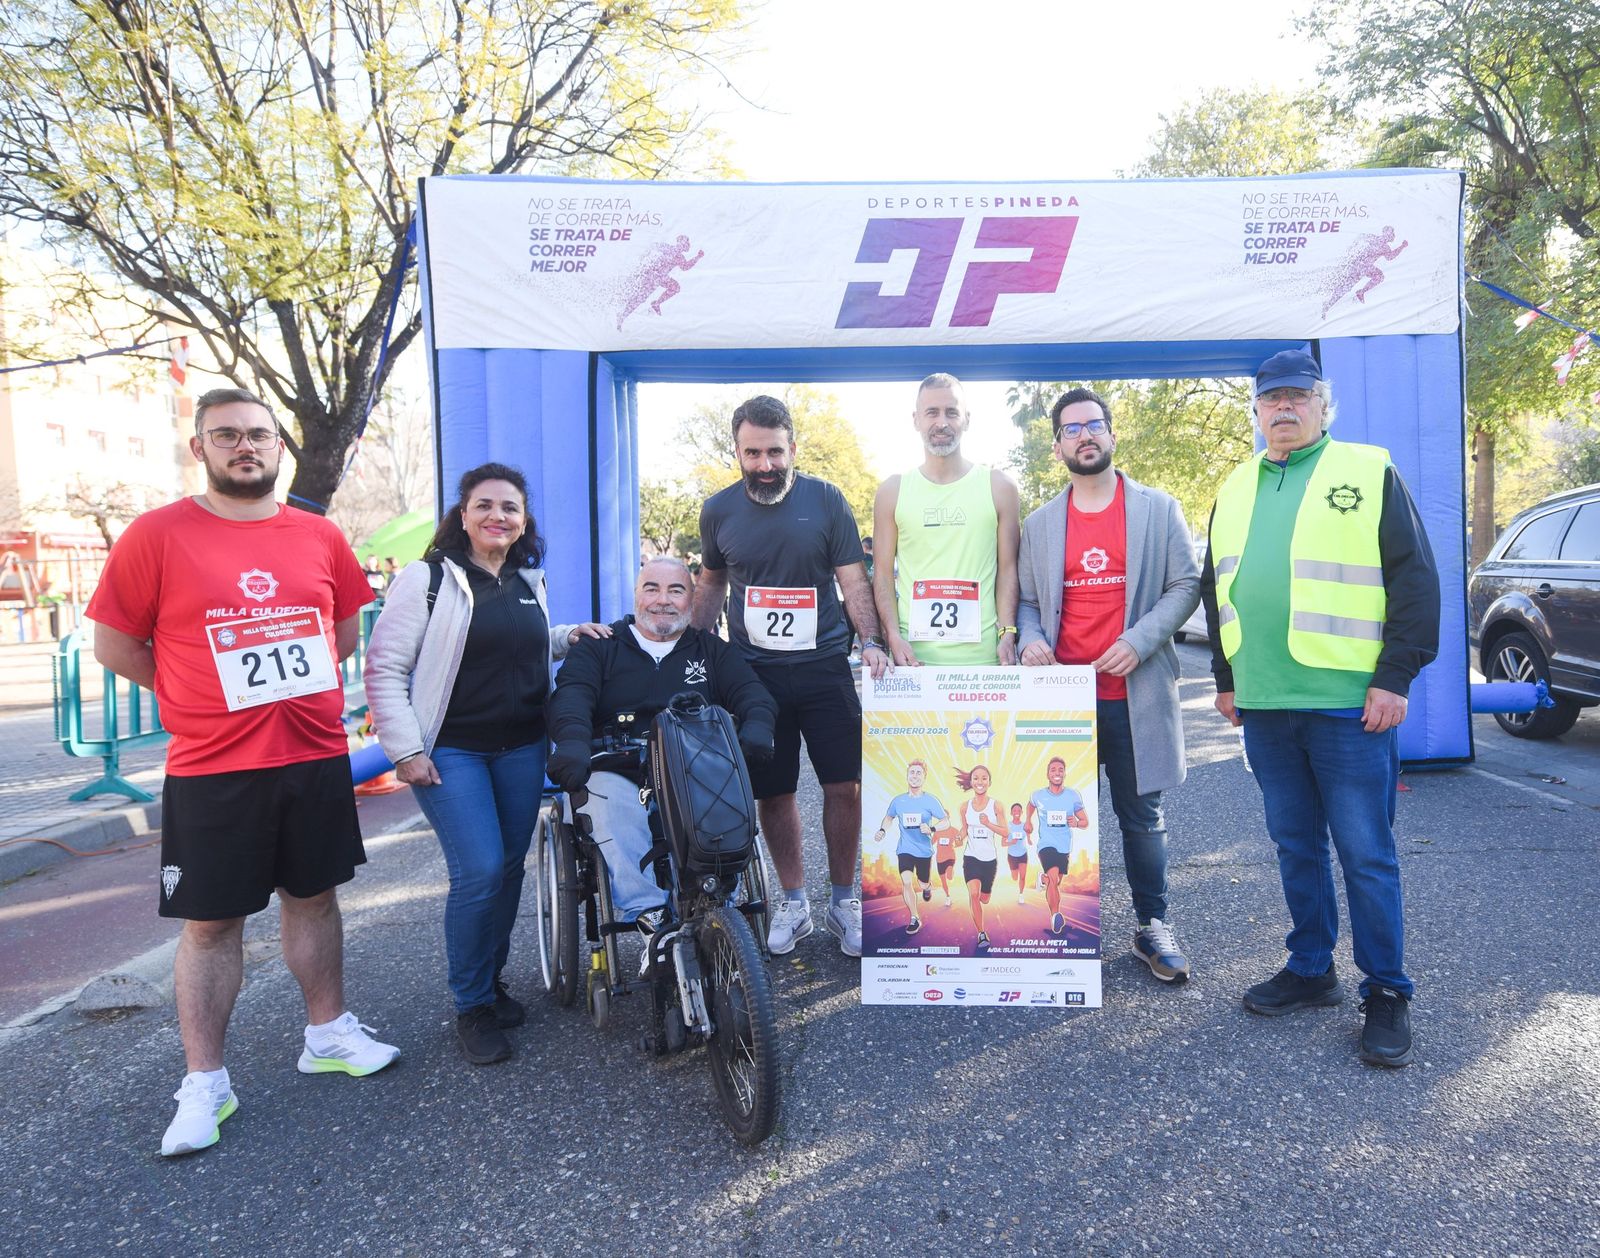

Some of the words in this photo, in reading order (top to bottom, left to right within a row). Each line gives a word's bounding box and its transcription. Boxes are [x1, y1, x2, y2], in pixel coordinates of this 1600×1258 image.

[528, 198, 553, 210] NO
[557, 198, 577, 210] SE
[584, 198, 631, 210] TRATA
[1242, 193, 1266, 204] NO
[1270, 193, 1288, 204] SE
[1293, 192, 1339, 204] TRATA
[1243, 207, 1263, 219] DE
[1268, 206, 1330, 219] CORRER
[1334, 203, 1370, 219] MÁS,
[528, 213, 550, 226] DE
[555, 212, 622, 226] CORRER
[626, 210, 663, 227] MÁS,
[1244, 222, 1263, 234] SE
[1267, 221, 1316, 234] TRATA
[1319, 221, 1340, 233] DE
[529, 228, 551, 241] SE
[555, 228, 605, 241] TRATA
[609, 228, 632, 241] DE
[1243, 237, 1307, 249] CORRER
[529, 244, 596, 257] CORRER
[1244, 252, 1298, 264] MEJOR
[530, 260, 587, 273] MEJOR
[923, 506, 967, 523] FILA
[206, 608, 247, 619] MILLA
[930, 602, 959, 629] 23
[767, 612, 794, 637] 22
[243, 627, 260, 635] MILLA
[241, 644, 311, 688] 213
[1046, 676, 1089, 685] IMDECO
[874, 683, 921, 693] populares
[948, 693, 1007, 702] CULDECOR
[881, 727, 925, 735] FEBRERO
[1047, 939, 1068, 947] META
